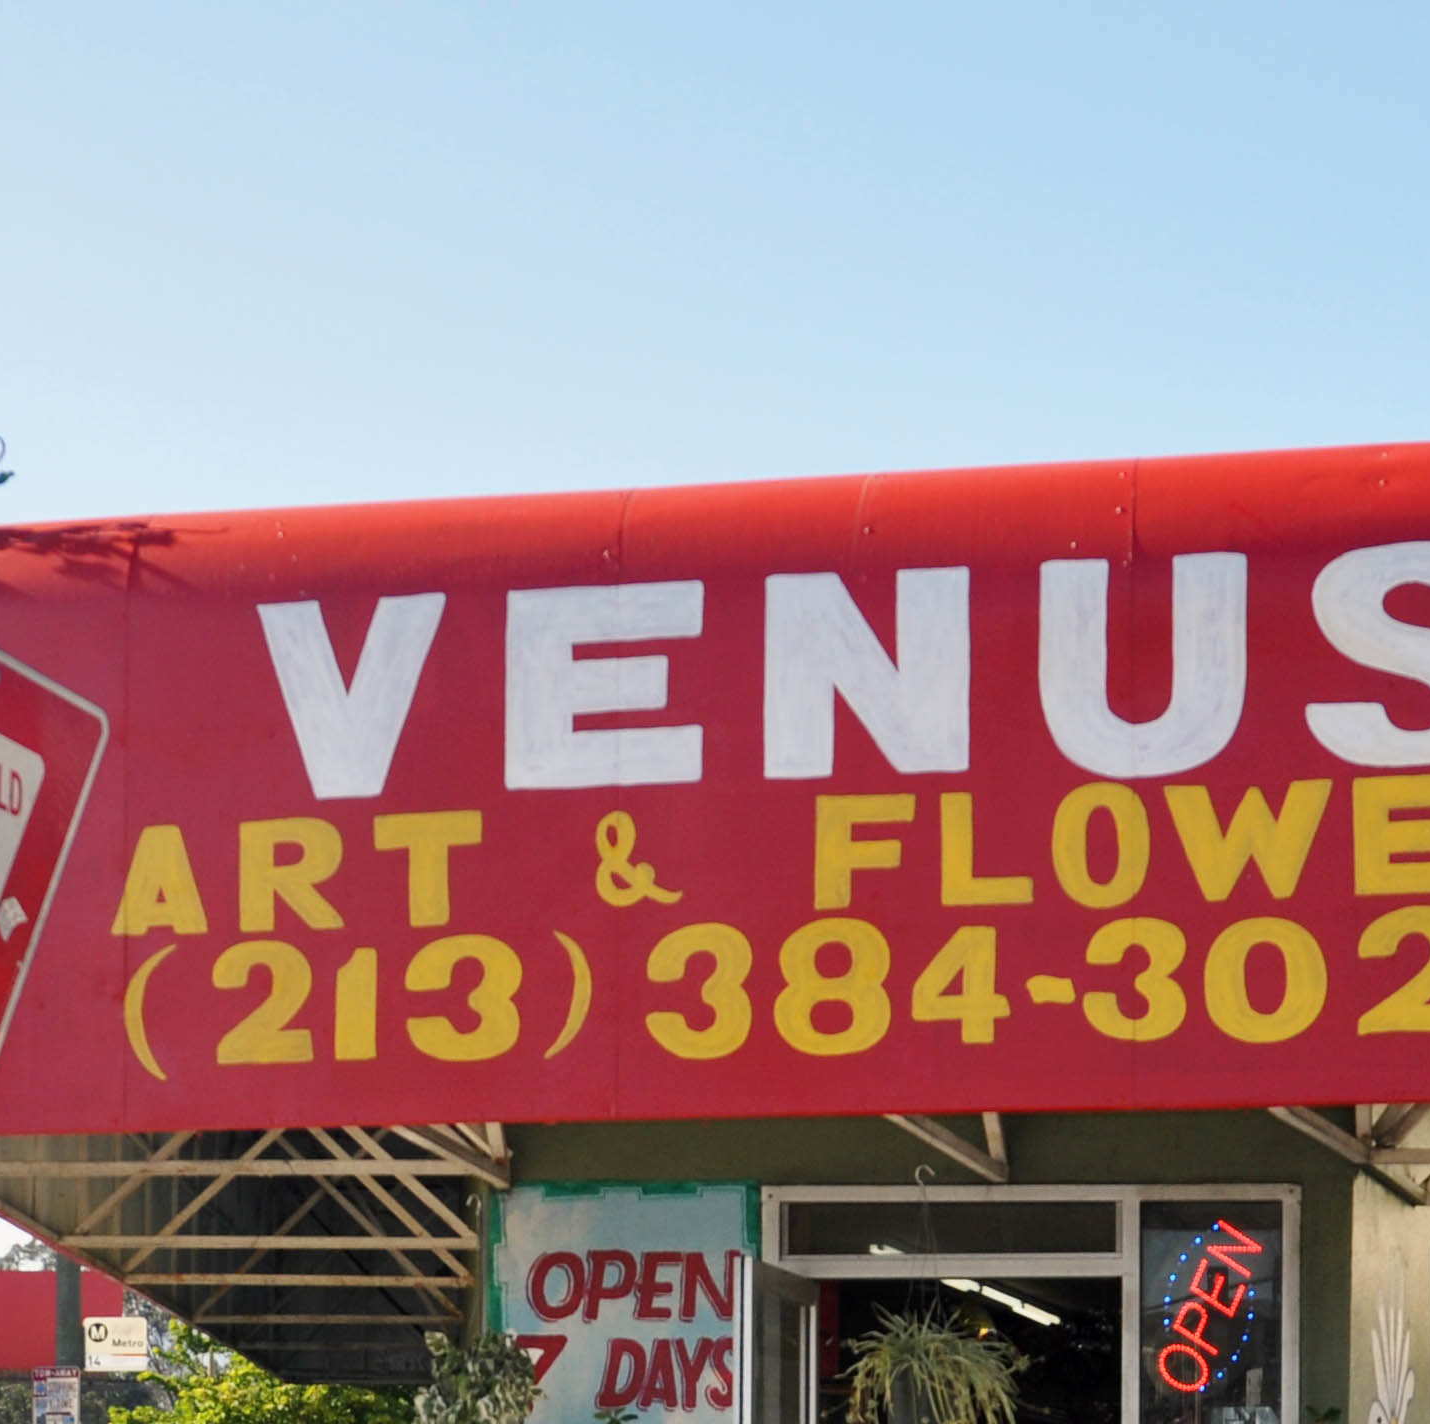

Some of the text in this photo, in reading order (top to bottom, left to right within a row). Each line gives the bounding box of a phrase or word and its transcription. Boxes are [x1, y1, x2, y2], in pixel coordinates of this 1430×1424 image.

[111, 810, 483, 936] ART
[595, 811, 683, 908] &
[124, 932, 592, 1081] (213)
[527, 1249, 742, 1323] OPEN
[1157, 1218, 1264, 1392] OPEN
[112, 1339, 144, 1348] Metro
[516, 1334, 734, 1412] 7 DAYS
